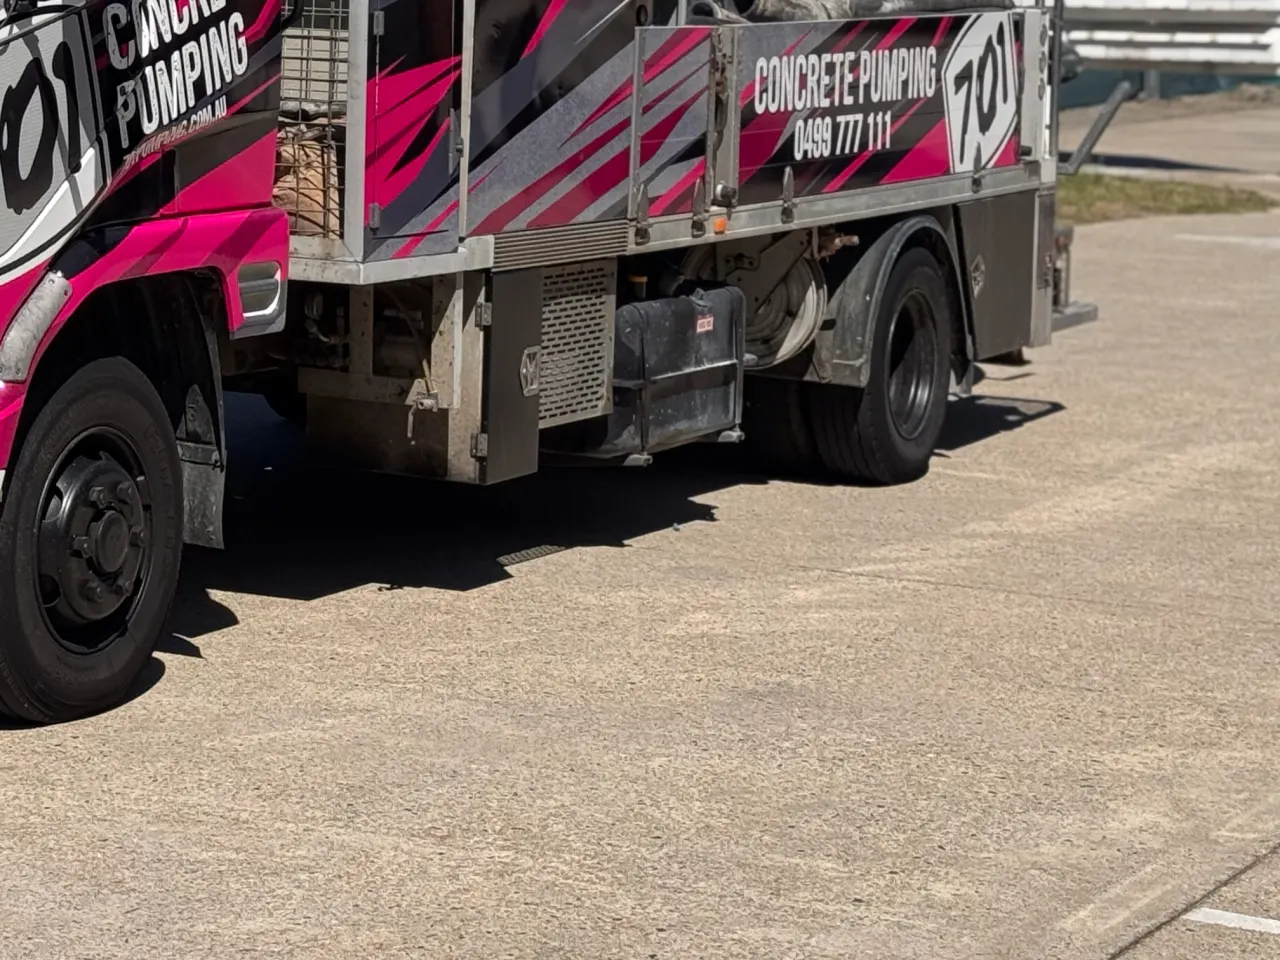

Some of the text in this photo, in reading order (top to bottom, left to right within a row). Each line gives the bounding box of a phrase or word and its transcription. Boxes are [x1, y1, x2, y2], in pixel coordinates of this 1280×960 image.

[115, 11, 249, 149] PUMPING
[754, 45, 937, 115] CONCRETE PUMPING
[953, 21, 1008, 165] 701
[793, 110, 891, 161] 0499 777 111
